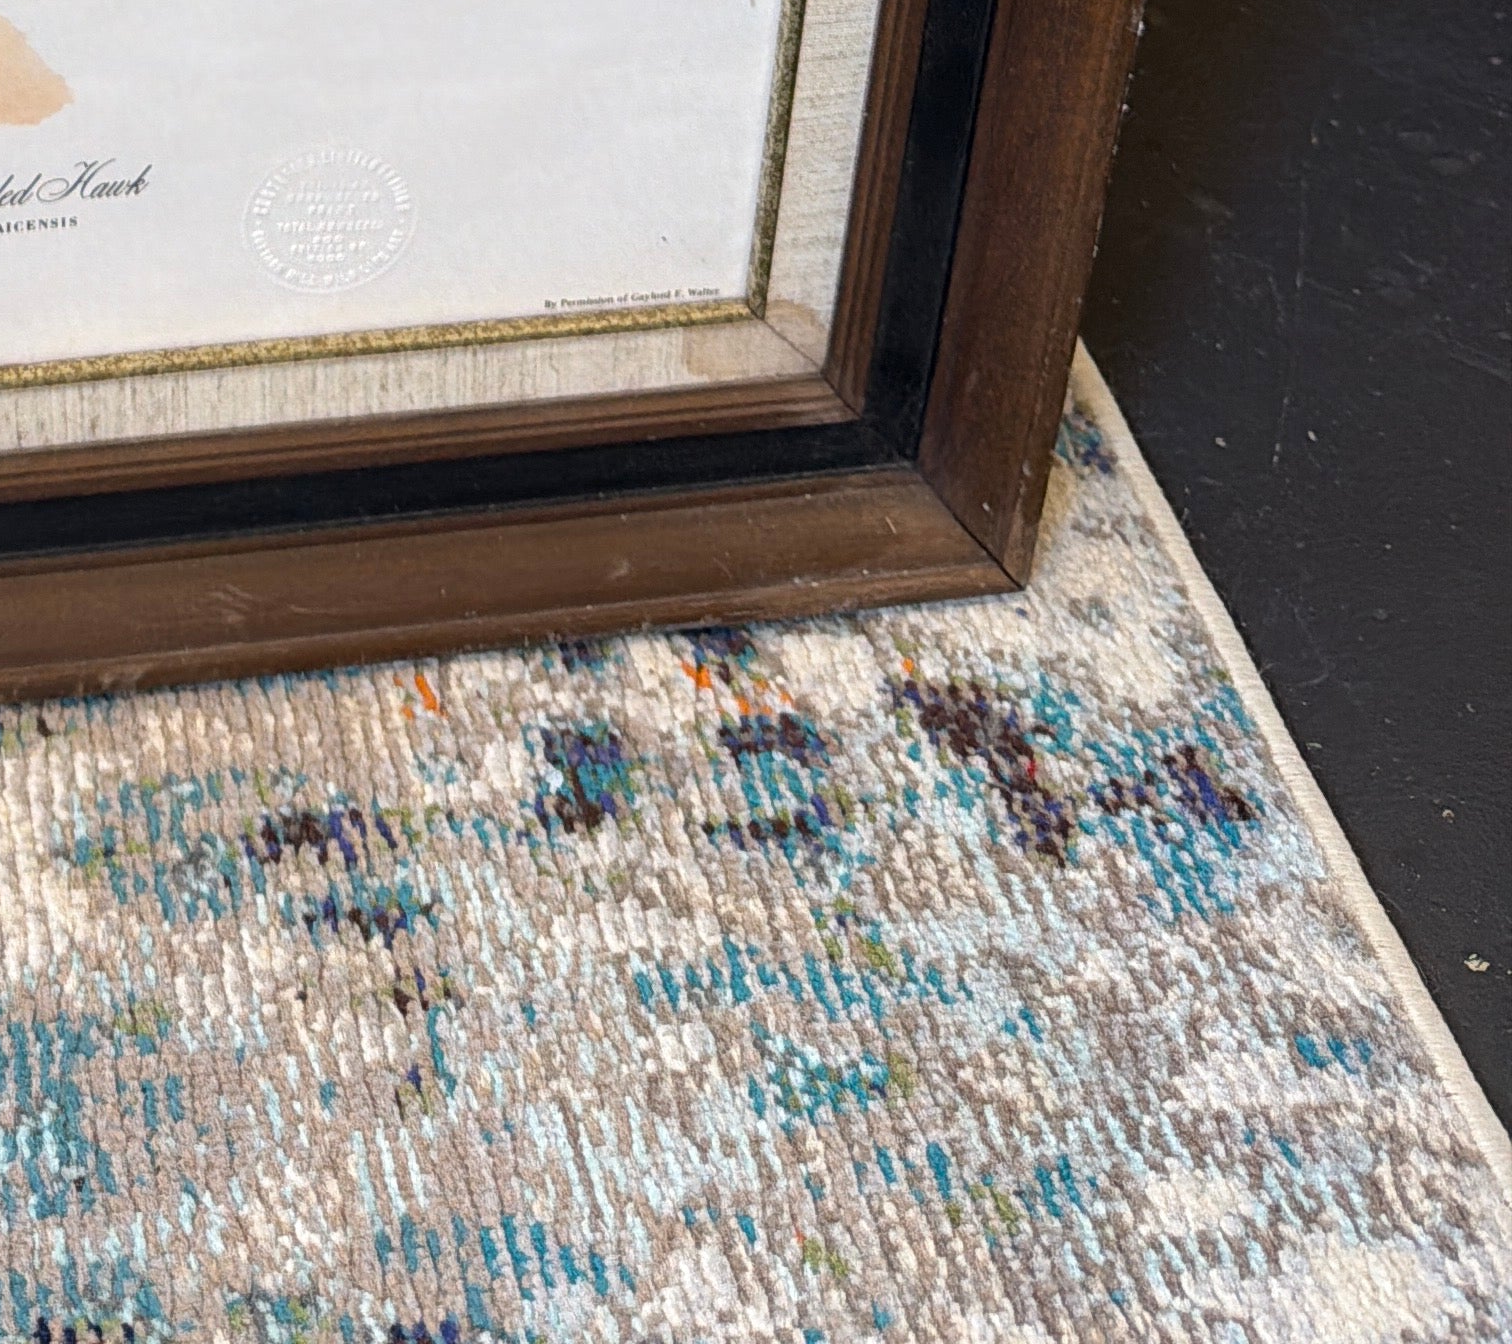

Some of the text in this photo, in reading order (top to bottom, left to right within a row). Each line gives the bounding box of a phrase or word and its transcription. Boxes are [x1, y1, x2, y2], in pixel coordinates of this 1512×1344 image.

[34, 157, 154, 202] Hawk
[560, 294, 614, 308] Permission
[616, 293, 629, 304] of
